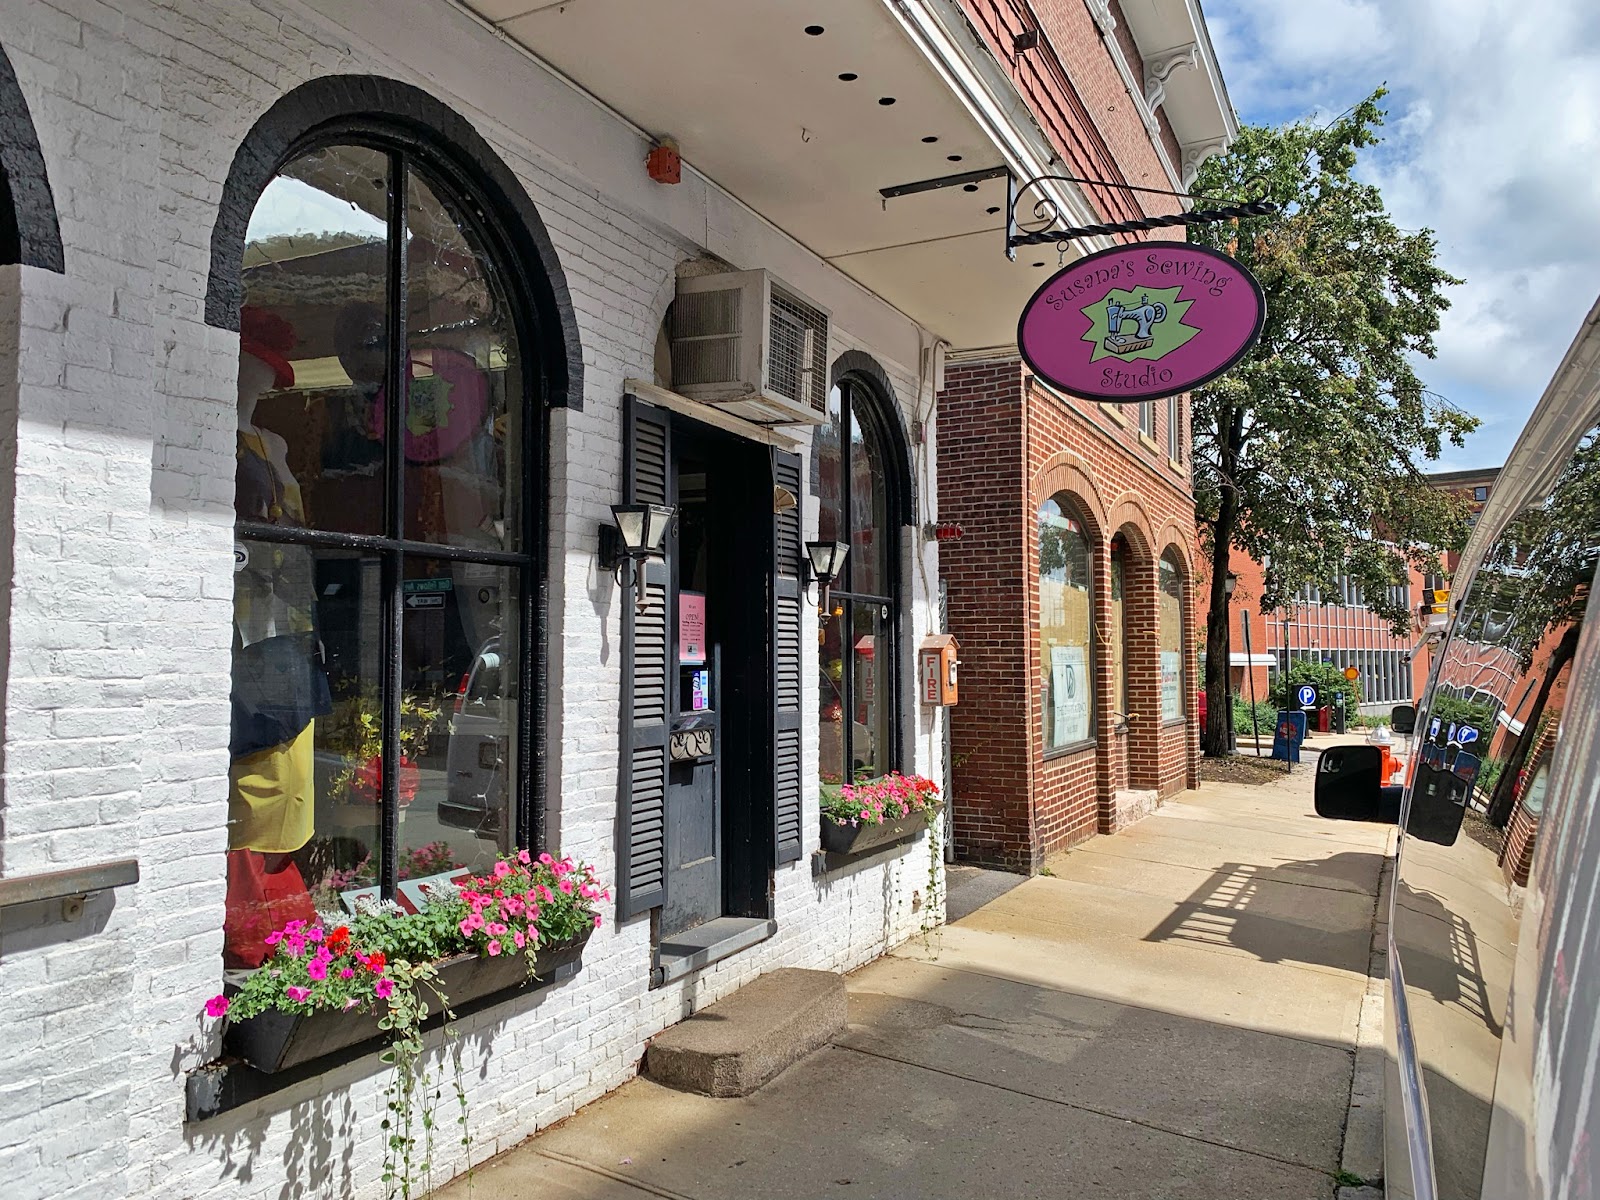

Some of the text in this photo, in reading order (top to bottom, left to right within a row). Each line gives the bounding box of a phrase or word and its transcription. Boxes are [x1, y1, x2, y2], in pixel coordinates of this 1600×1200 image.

[1045, 253, 1233, 311] Susana's Sewing
[1100, 364, 1173, 389] Studio
[926, 656, 937, 700] FIRE
[1303, 688, 1312, 703] P
